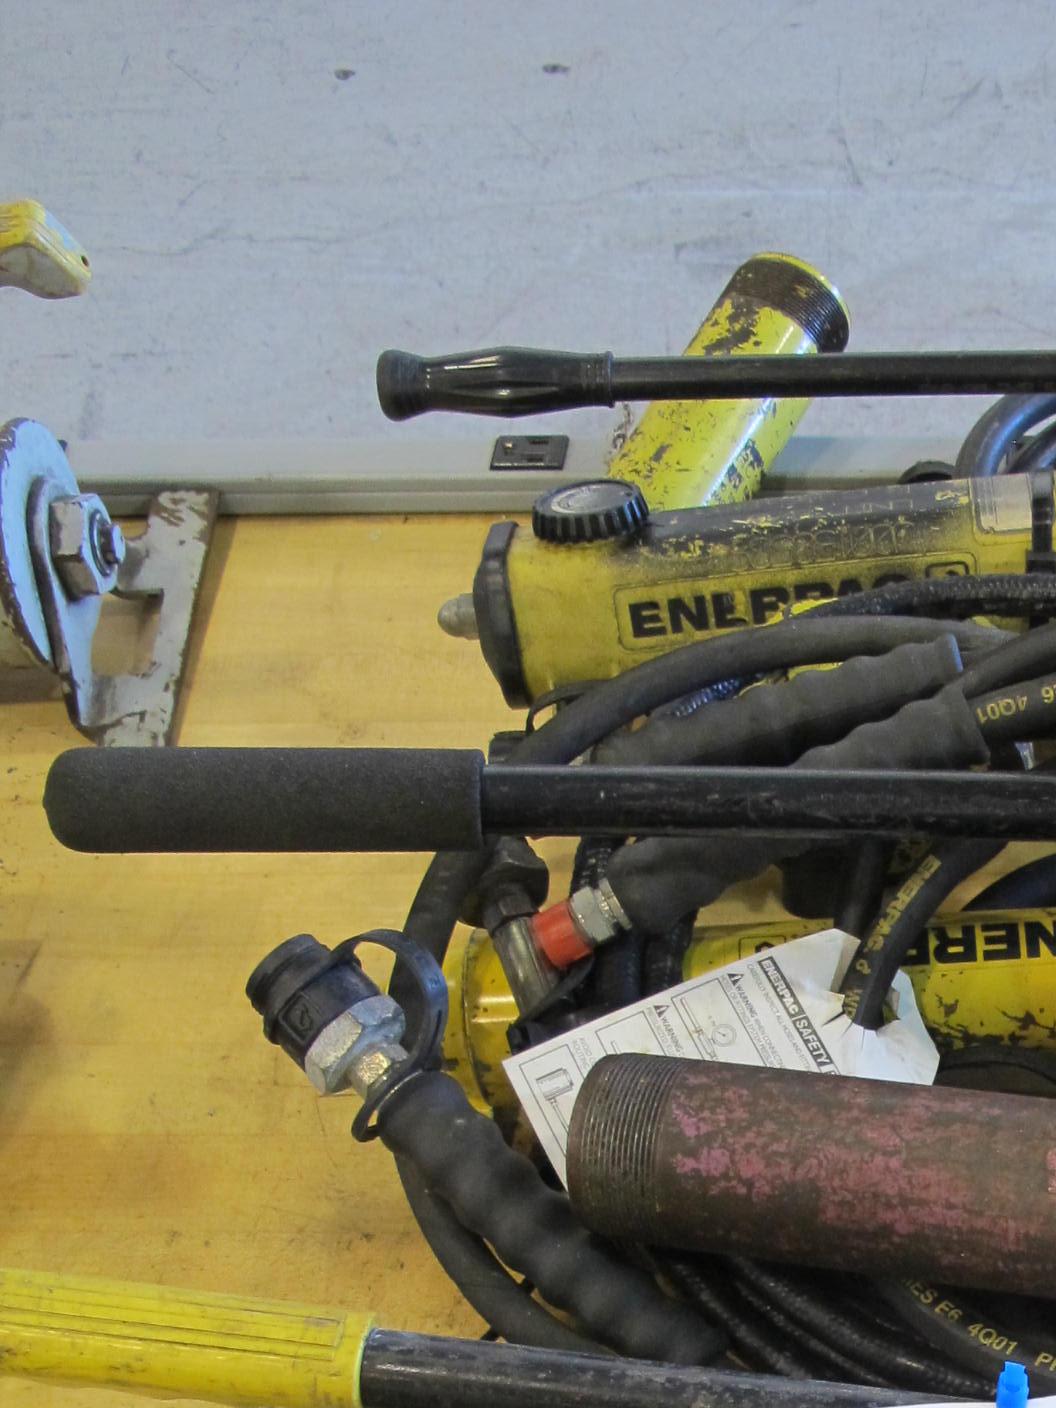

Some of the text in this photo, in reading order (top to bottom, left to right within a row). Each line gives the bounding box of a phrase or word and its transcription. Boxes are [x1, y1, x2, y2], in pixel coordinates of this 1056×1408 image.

[976, 695, 1028, 724] 4Q01
[733, 983, 758, 1019] WARNING
[759, 958, 830, 1067] ENERPAC SAFETY
[934, 1300, 965, 1323] E6
[967, 1322, 1018, 1356] 4Q01
